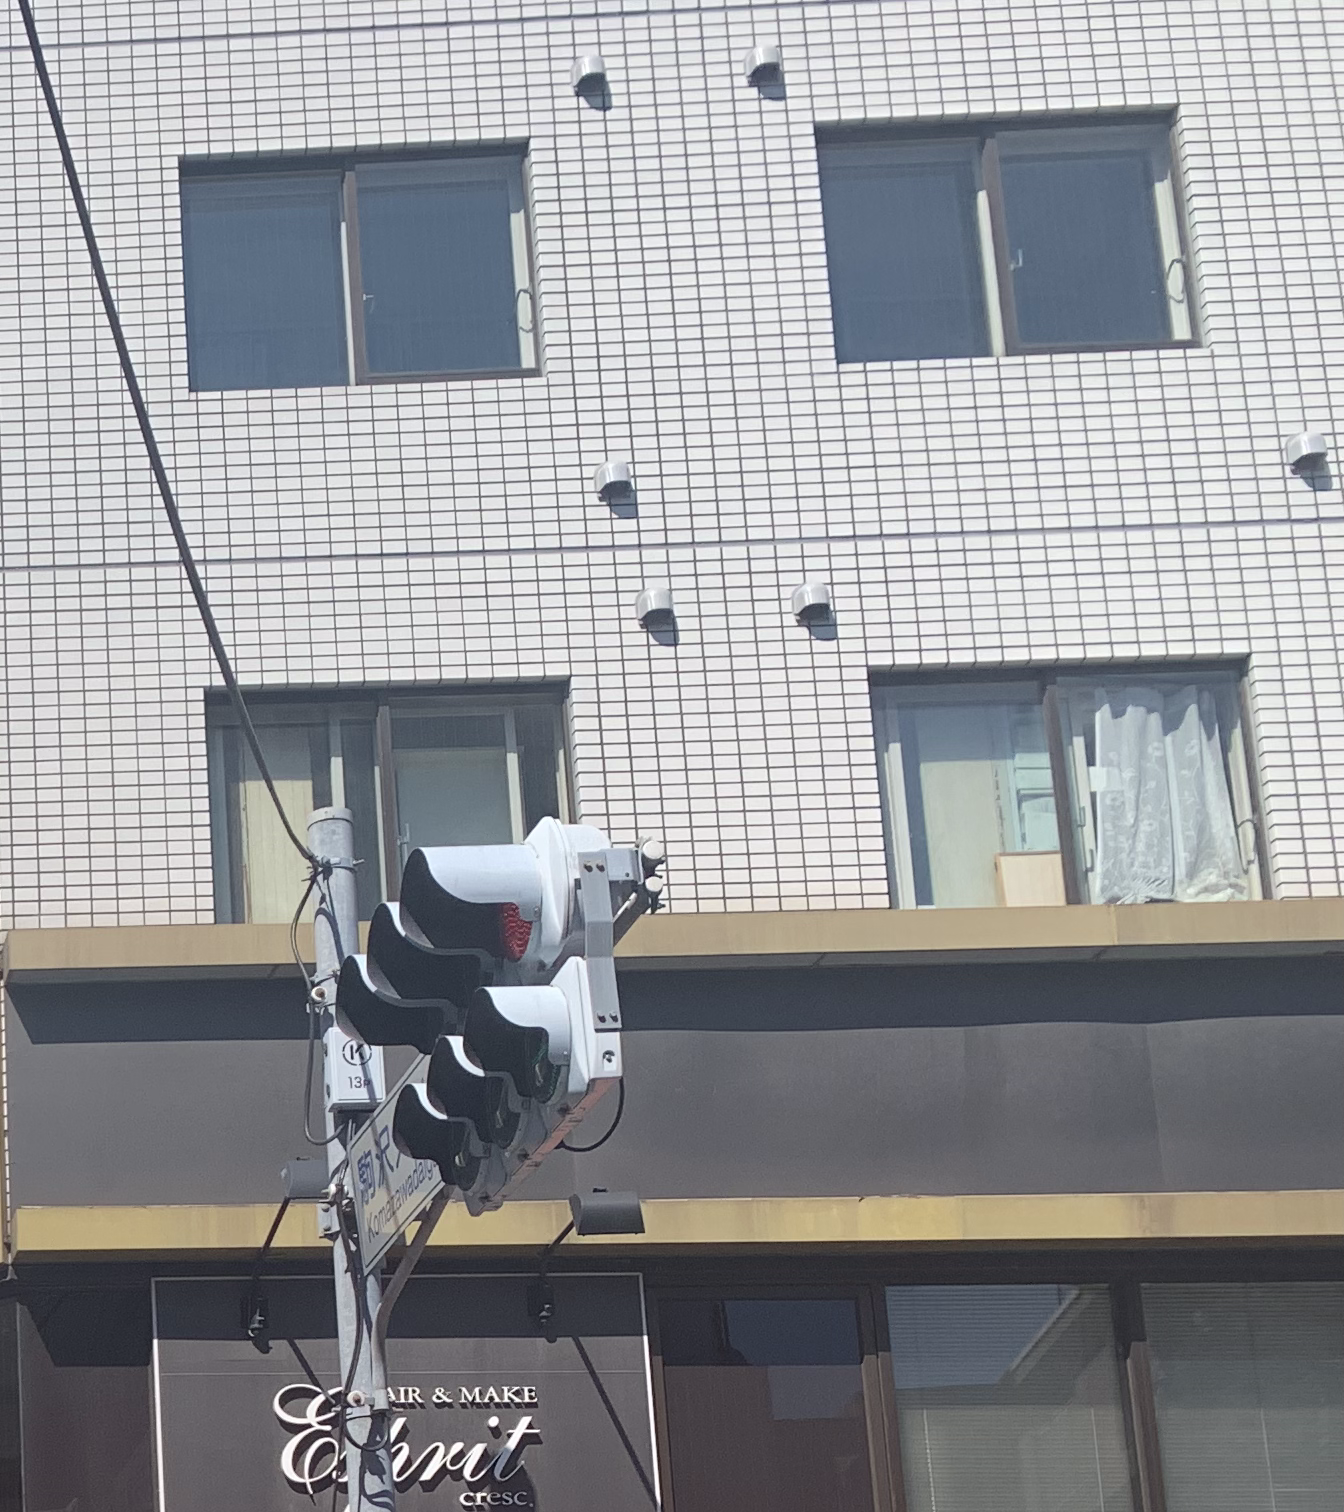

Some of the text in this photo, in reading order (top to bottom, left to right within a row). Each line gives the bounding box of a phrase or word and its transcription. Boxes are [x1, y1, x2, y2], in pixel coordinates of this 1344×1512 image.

[386, 1386, 538, 1405] AIR & MAKE
